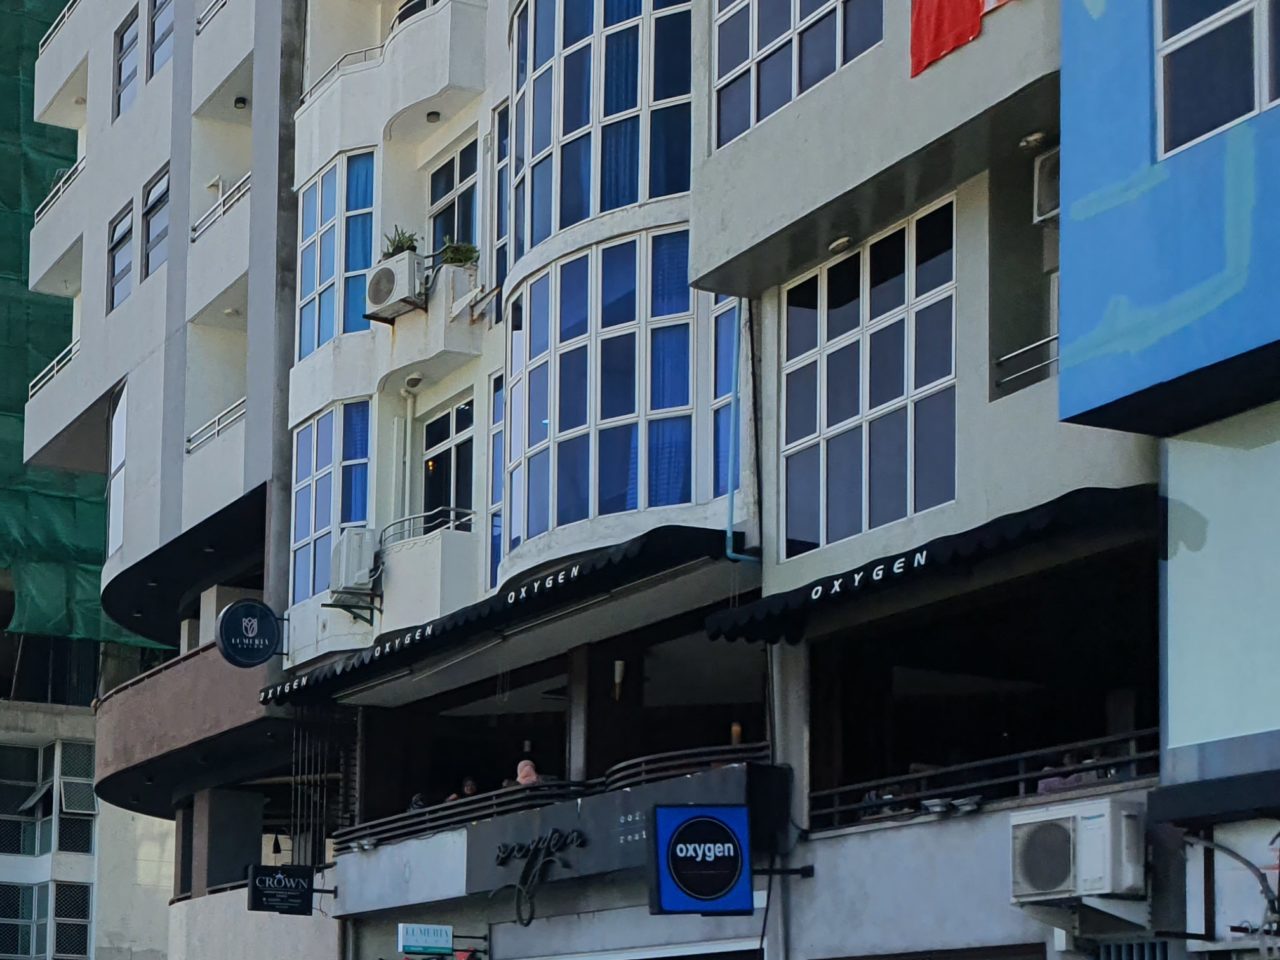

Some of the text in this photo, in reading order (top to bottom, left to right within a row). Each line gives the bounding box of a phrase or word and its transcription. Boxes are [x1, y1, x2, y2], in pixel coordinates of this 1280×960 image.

[507, 565, 579, 604] OXYGEN
[811, 550, 927, 600] OXYGEN
[374, 624, 432, 657] OXYGEN
[676, 843, 734, 862] oxygen
[256, 876, 308, 889] CROWN
